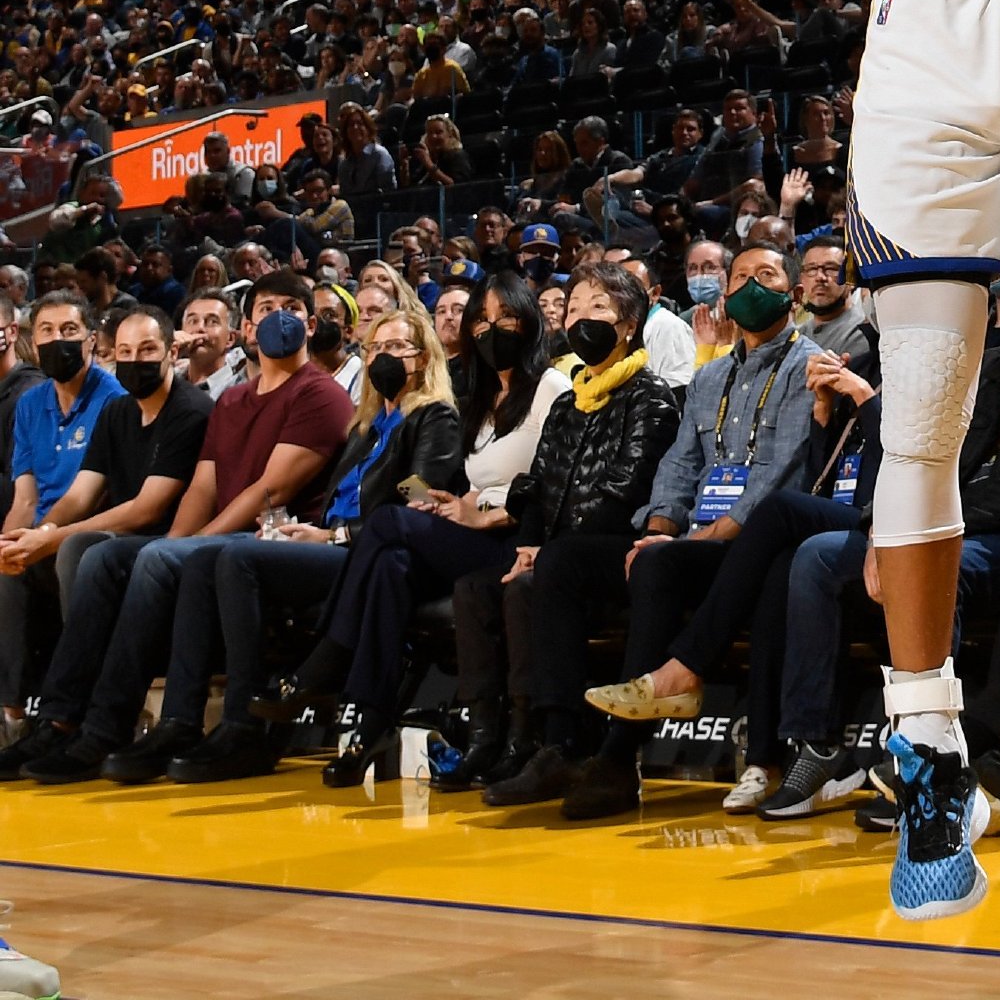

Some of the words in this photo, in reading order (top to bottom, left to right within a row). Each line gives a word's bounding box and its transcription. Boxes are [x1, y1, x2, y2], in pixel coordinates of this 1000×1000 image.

[152, 129, 282, 180] Ringntral
[700, 503, 732, 511] PARTNER
[654, 716, 731, 742] HASE
